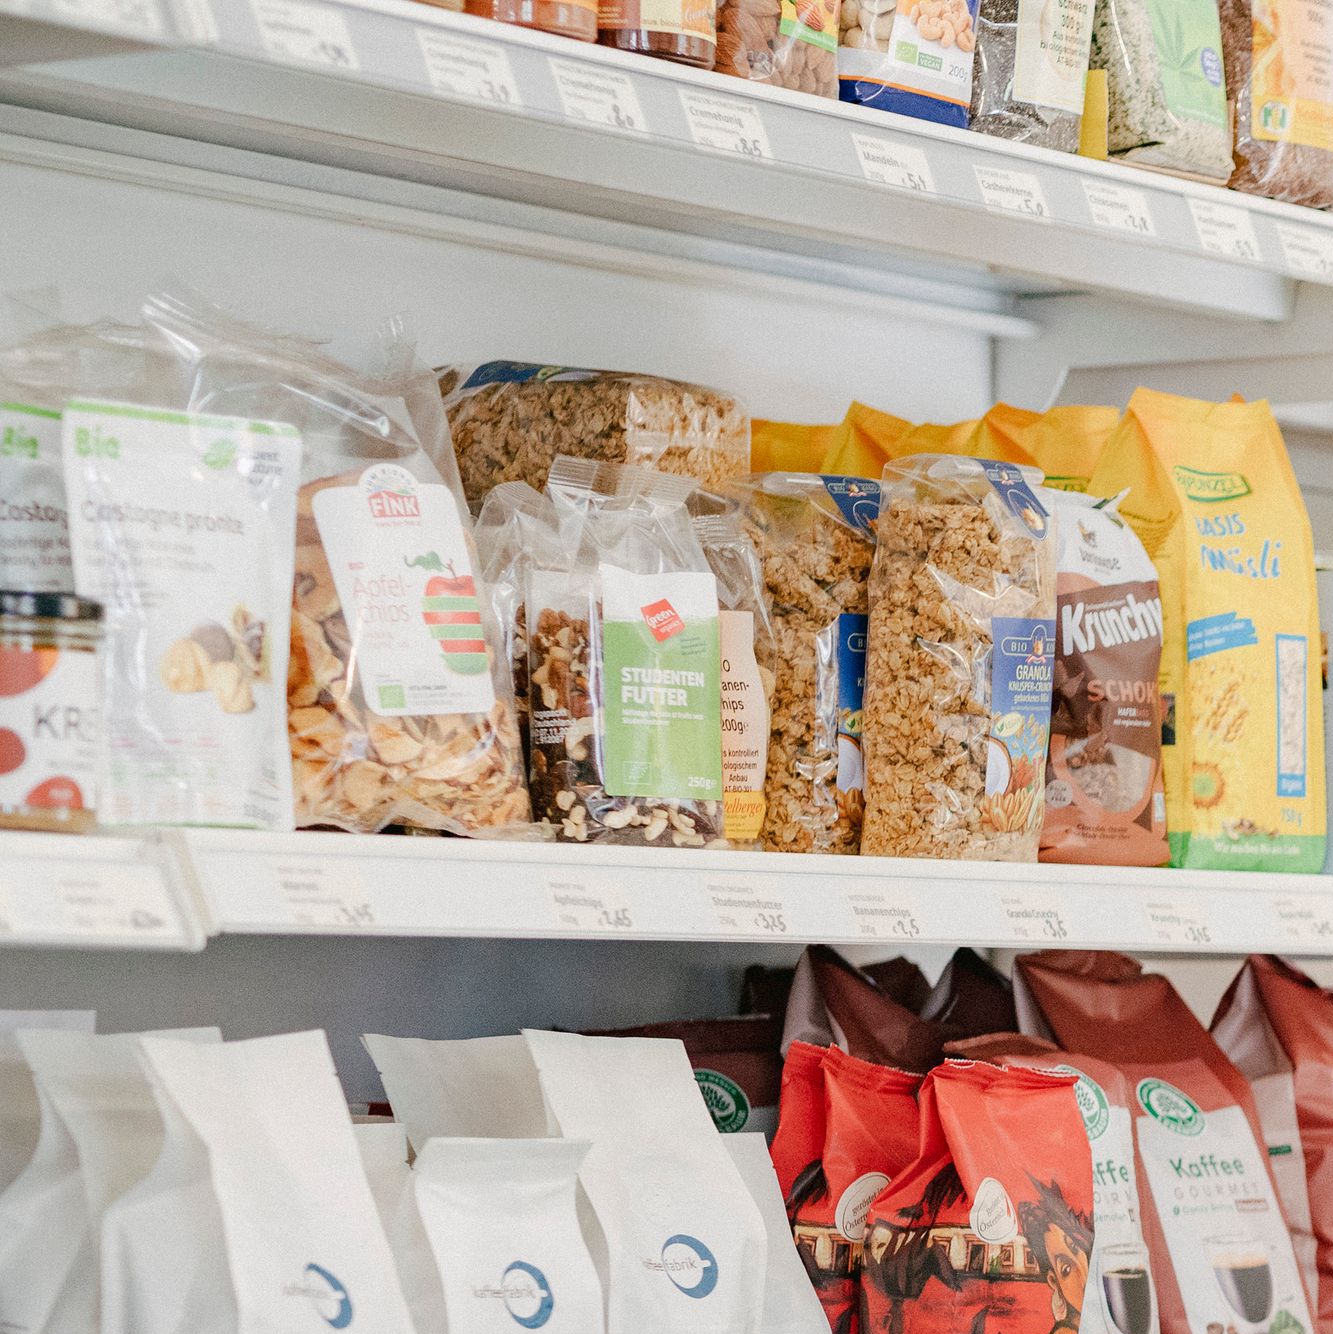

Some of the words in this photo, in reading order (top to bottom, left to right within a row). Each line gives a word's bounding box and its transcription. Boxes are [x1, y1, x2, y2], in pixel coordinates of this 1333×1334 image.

[919, 57, 941, 71] VEGAN
[861, 150, 900, 167] Mandeln
[371, 494, 421, 518] FINK
[1200, 540, 1281, 579] Müsli
[1062, 594, 1162, 656] Krunchy
[1011, 642, 1028, 652] BIO
[620, 667, 706, 688] STUDENTEN
[621, 686, 688, 707] FUTTER
[722, 699, 744, 713] hips
[723, 761, 757, 772] ologischem
[729, 773, 748, 783] Anbau
[724, 796, 763, 814] telberger
[712, 897, 783, 911] Studentenfutter
[852, 906, 912, 918] Bananenchips
[758, 912, 787, 933] 3,25
[1167, 1153, 1245, 1180] Kaffee
